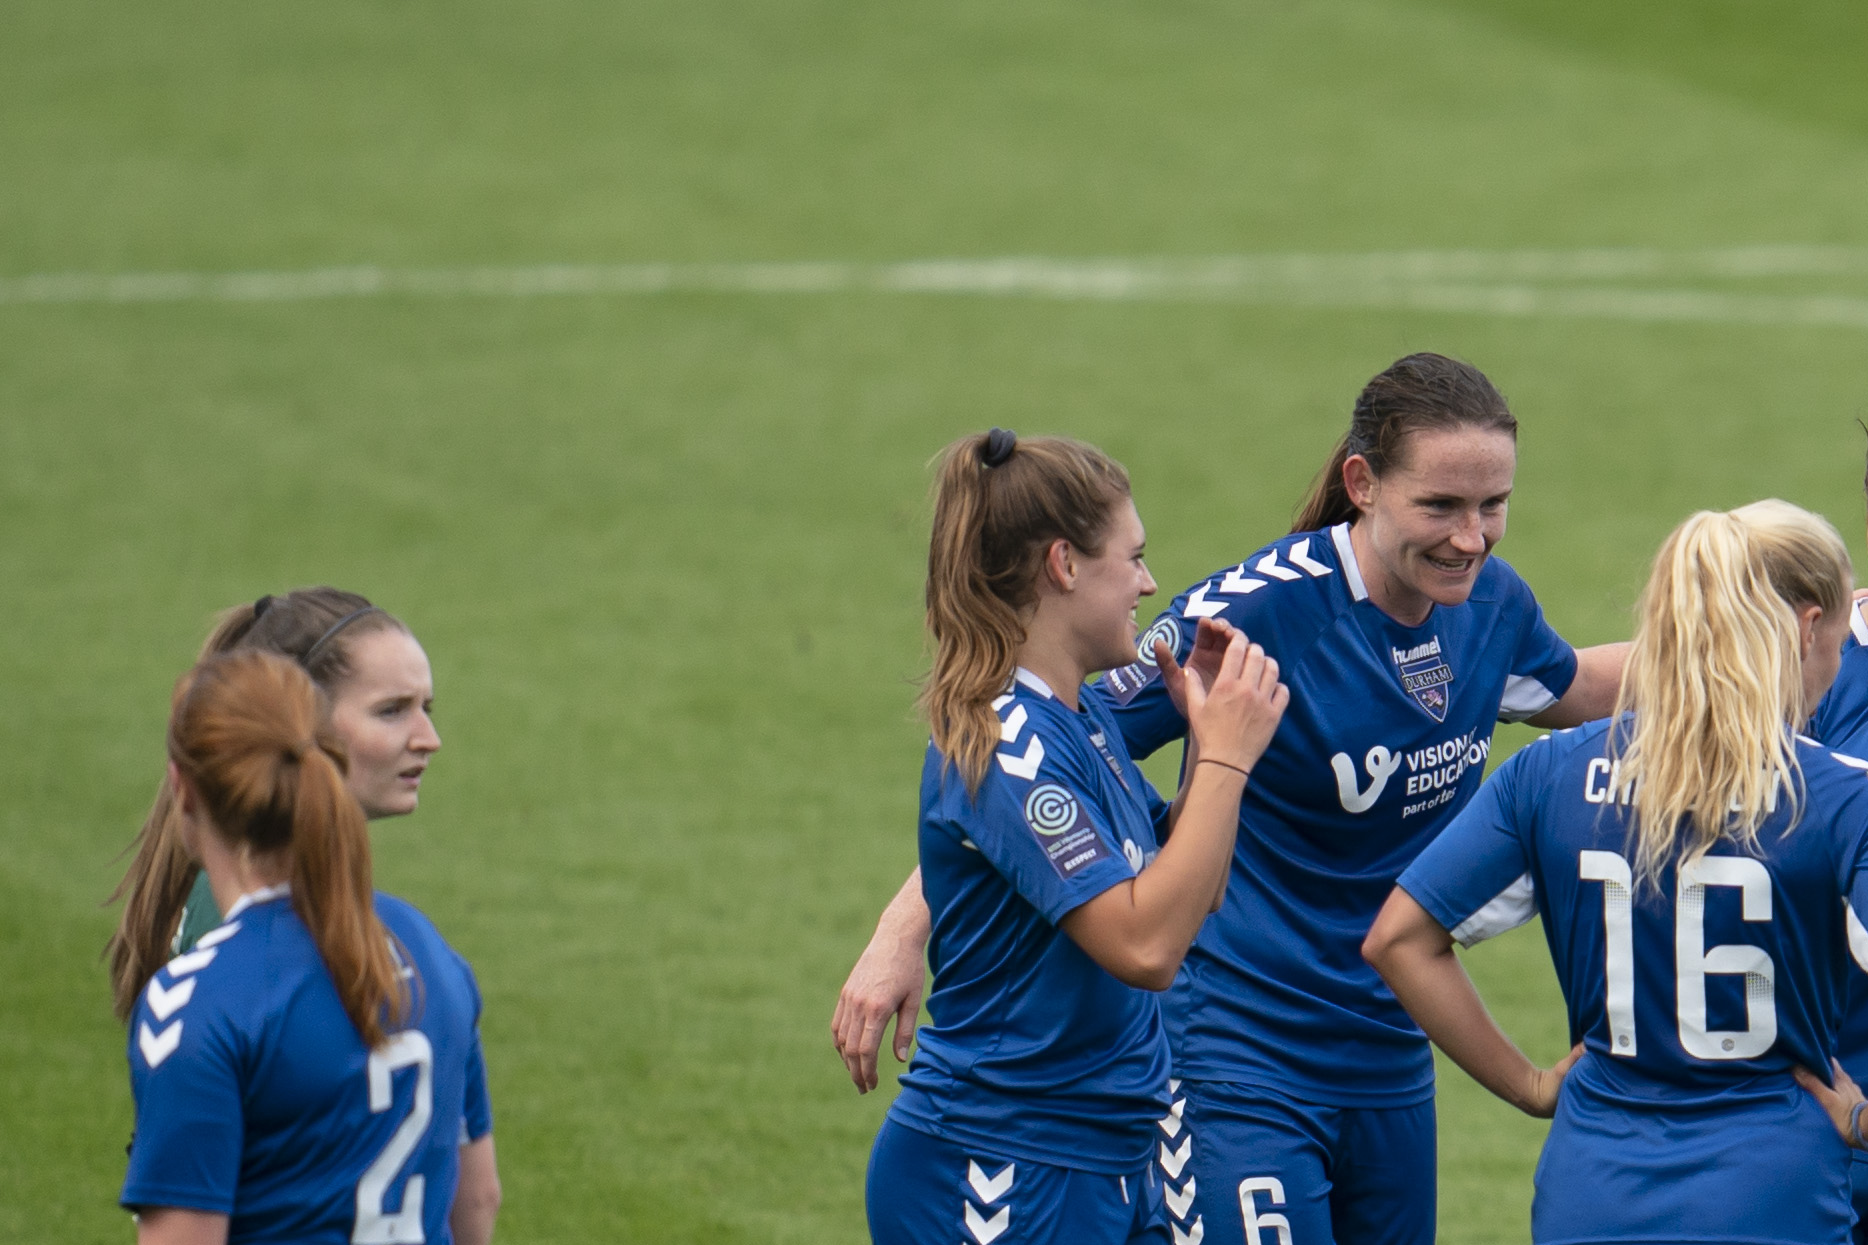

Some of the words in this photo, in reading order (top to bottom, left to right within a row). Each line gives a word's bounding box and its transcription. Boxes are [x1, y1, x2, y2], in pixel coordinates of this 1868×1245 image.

[1392, 635, 1442, 665] hummel
[1404, 668, 1450, 690] DURHAM
[1406, 734, 1468, 772] VISION
[1402, 800, 1427, 819] part
[1579, 849, 1778, 1060] 16
